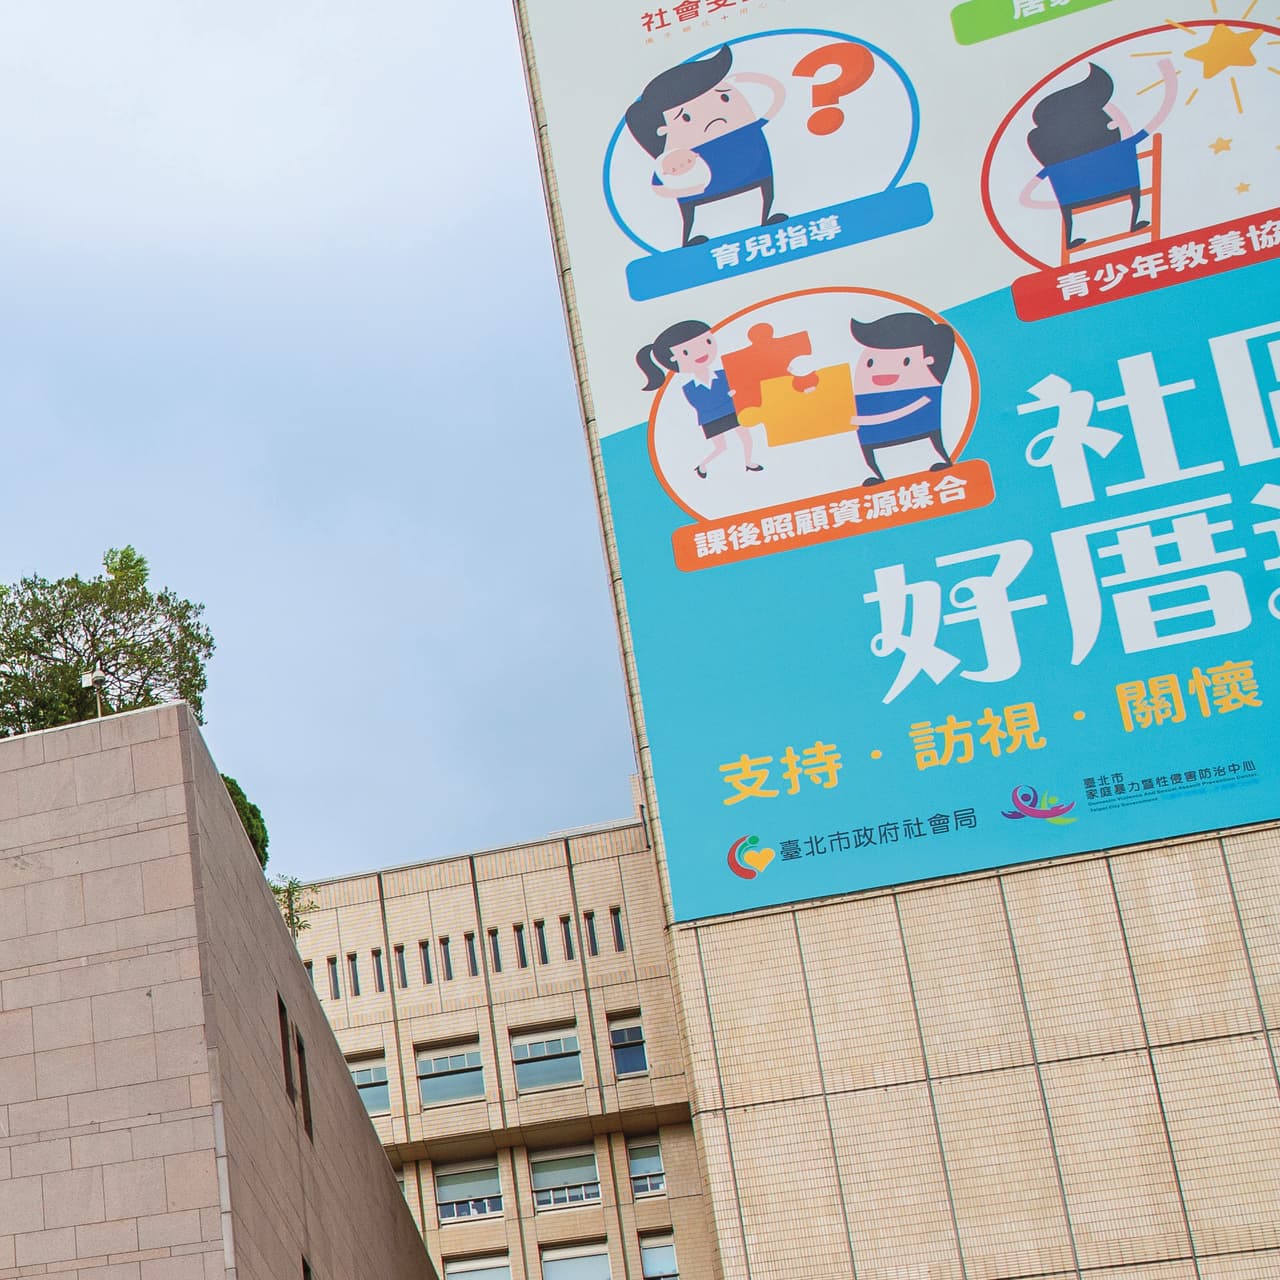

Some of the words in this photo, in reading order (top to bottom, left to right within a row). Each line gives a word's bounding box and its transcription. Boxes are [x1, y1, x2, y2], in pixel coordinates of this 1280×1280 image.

[711, 215, 842, 270] 育兒指導
[694, 475, 967, 559] 課後照顧資源媒合
[864, 483, 1280, 704] 好厝
[780, 808, 977, 861] 臺北市政府社會局
